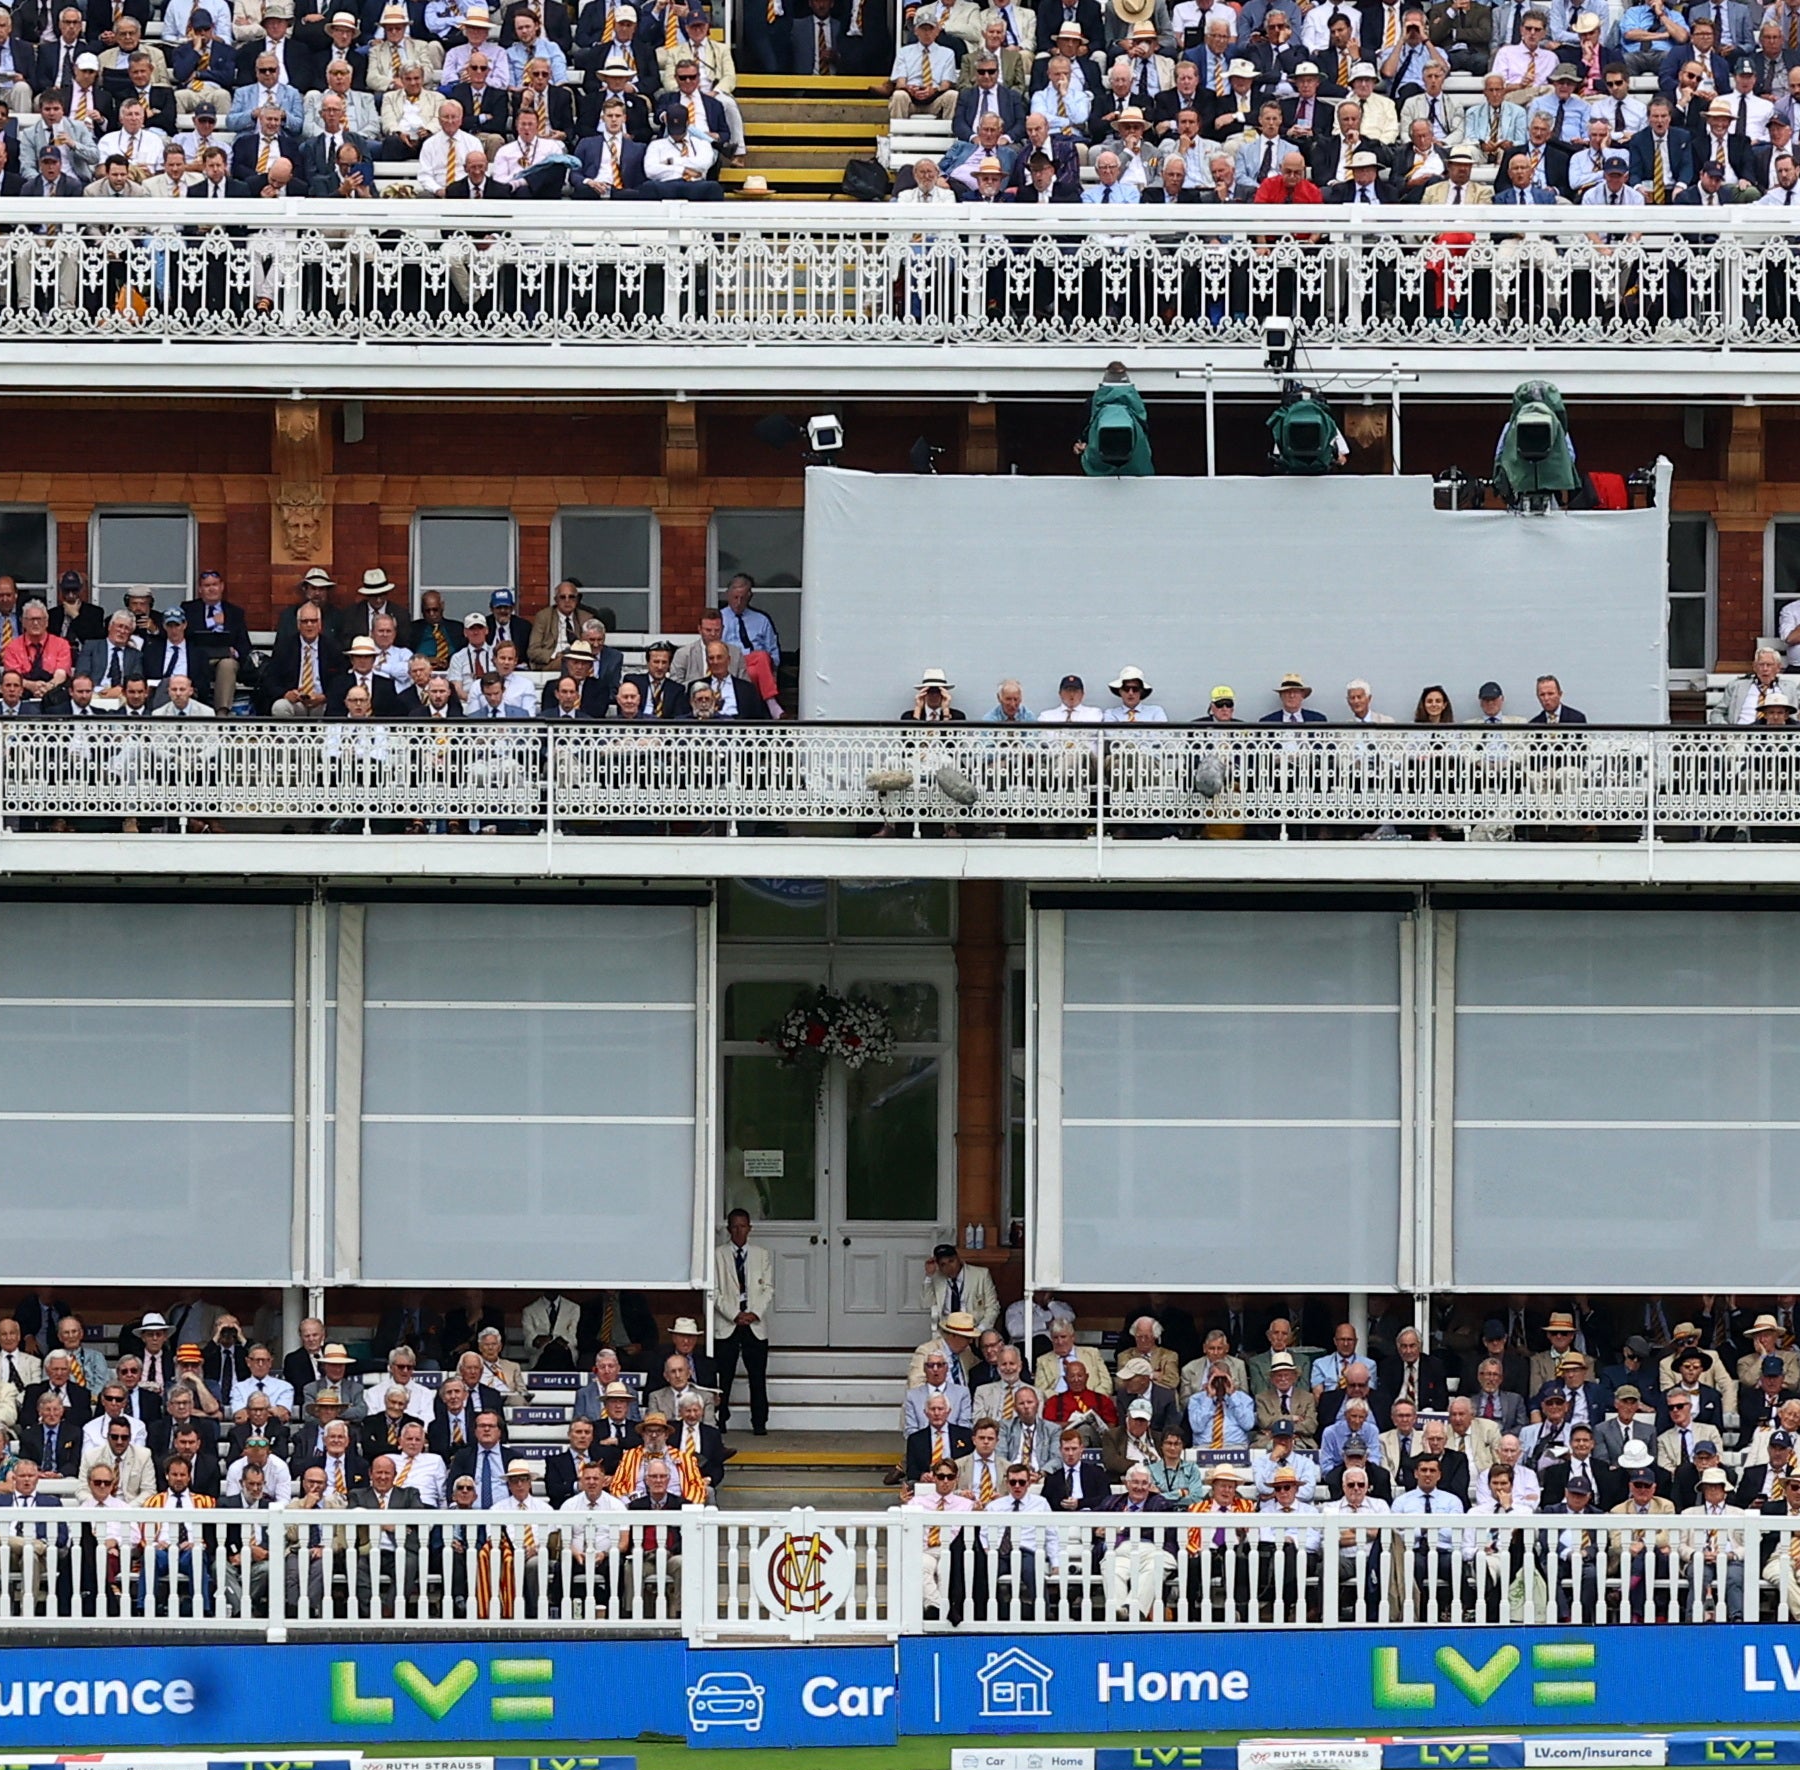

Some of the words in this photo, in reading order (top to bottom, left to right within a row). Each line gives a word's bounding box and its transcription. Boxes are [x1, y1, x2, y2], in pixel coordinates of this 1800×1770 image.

[801, 1676, 896, 1717] Car
[1098, 1661, 1249, 1702] Home
[1273, 1751, 1310, 1759] RUTH
[1313, 1750, 1369, 1758] STRAUSS
[1534, 1747, 1653, 1759] LV.com/insurance
[386, 1762, 423, 1770] RUTH
[426, 1762, 482, 1770] STRAUSS
[986, 1757, 1005, 1766] Car
[1052, 1756, 1083, 1767] Home
